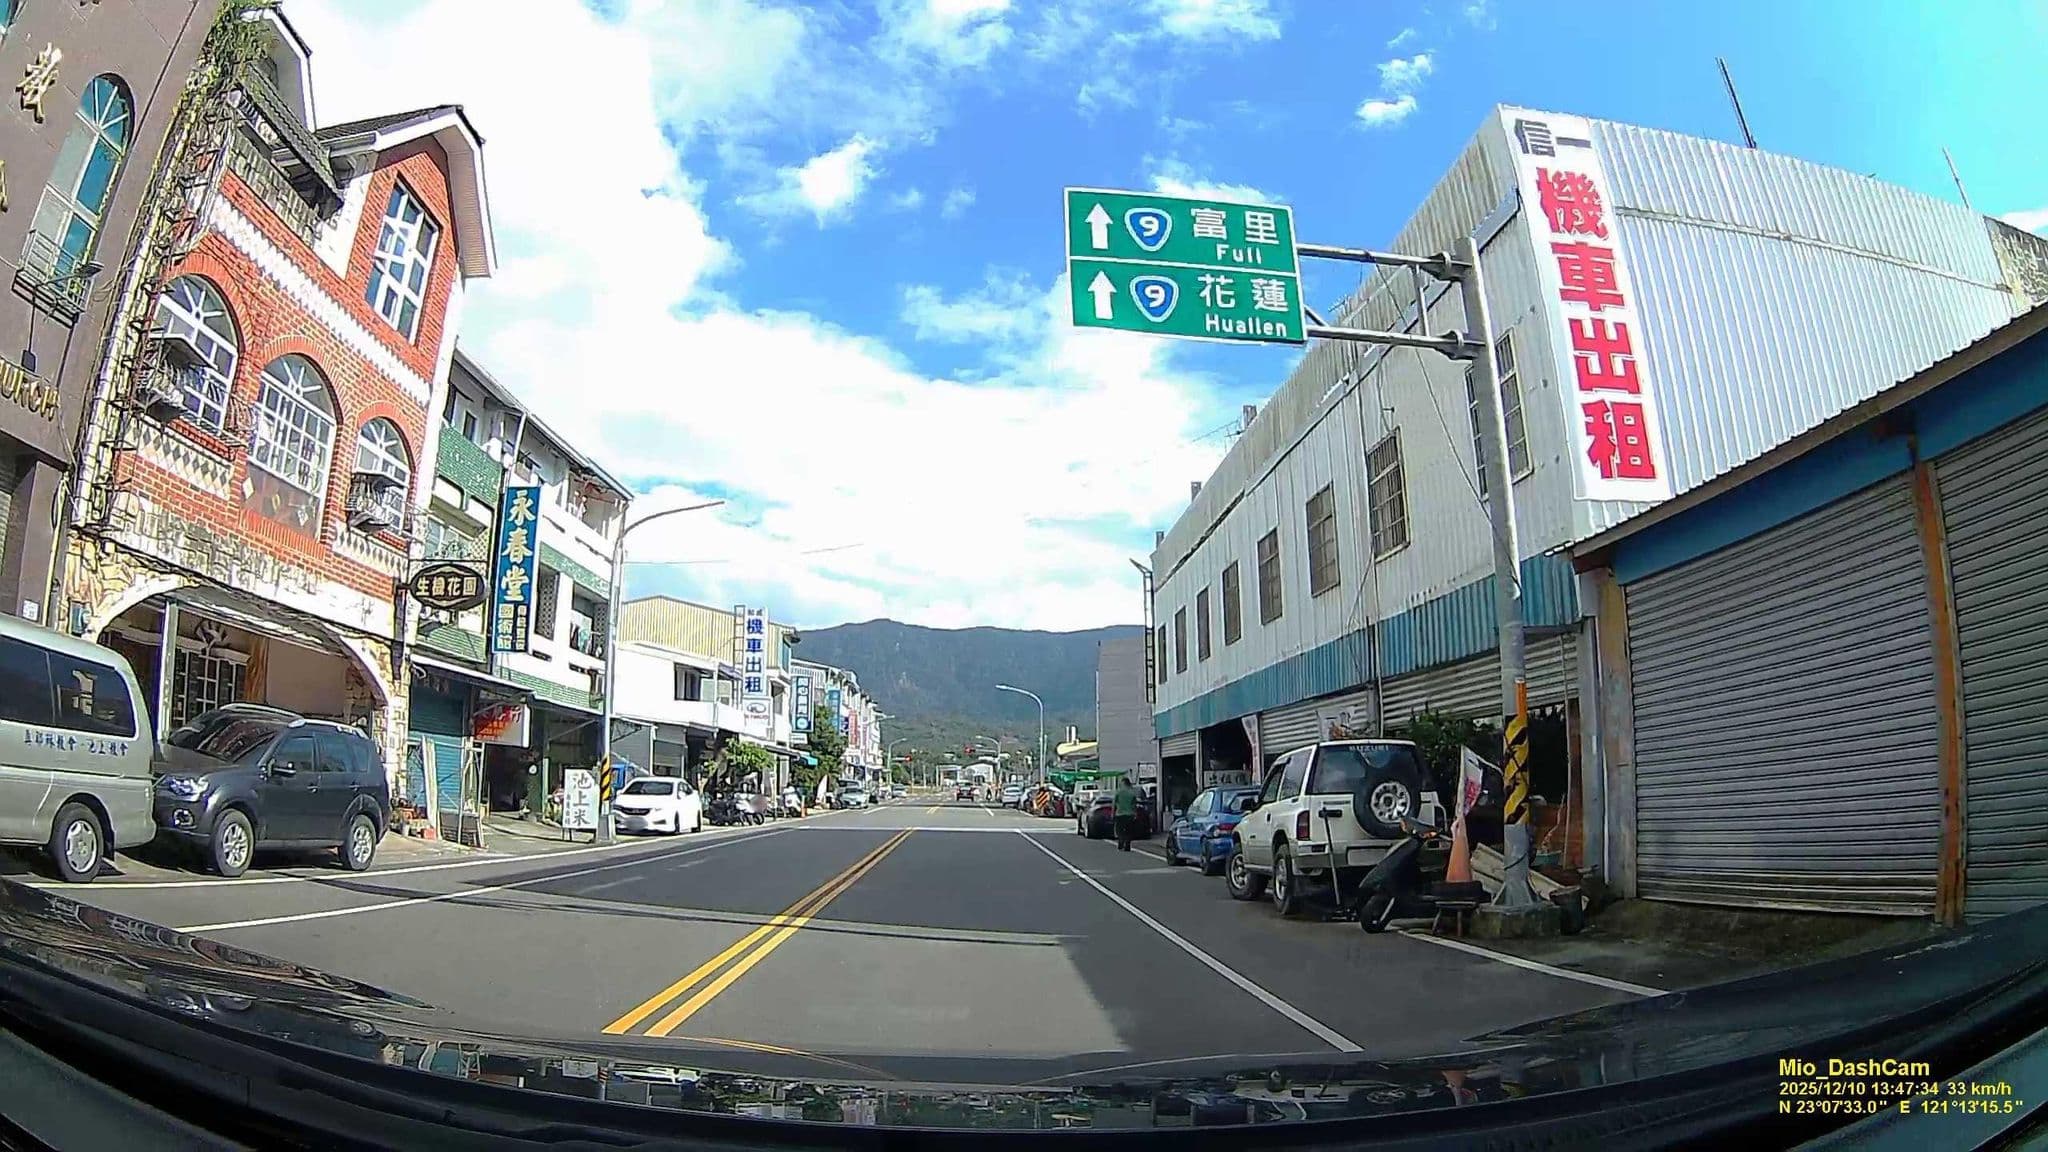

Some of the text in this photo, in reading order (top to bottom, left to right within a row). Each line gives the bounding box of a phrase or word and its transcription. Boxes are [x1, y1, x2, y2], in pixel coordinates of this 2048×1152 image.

[1514, 118, 1592, 157] 信一
[1139, 207, 1280, 245] 9 富里
[1144, 273, 1289, 312] 9 花蓮
[1536, 167, 1657, 480] 機車出租
[501, 489, 536, 601] 永春堂
[744, 618, 764, 693] 機車出租
[572, 772, 592, 826] 池上米
